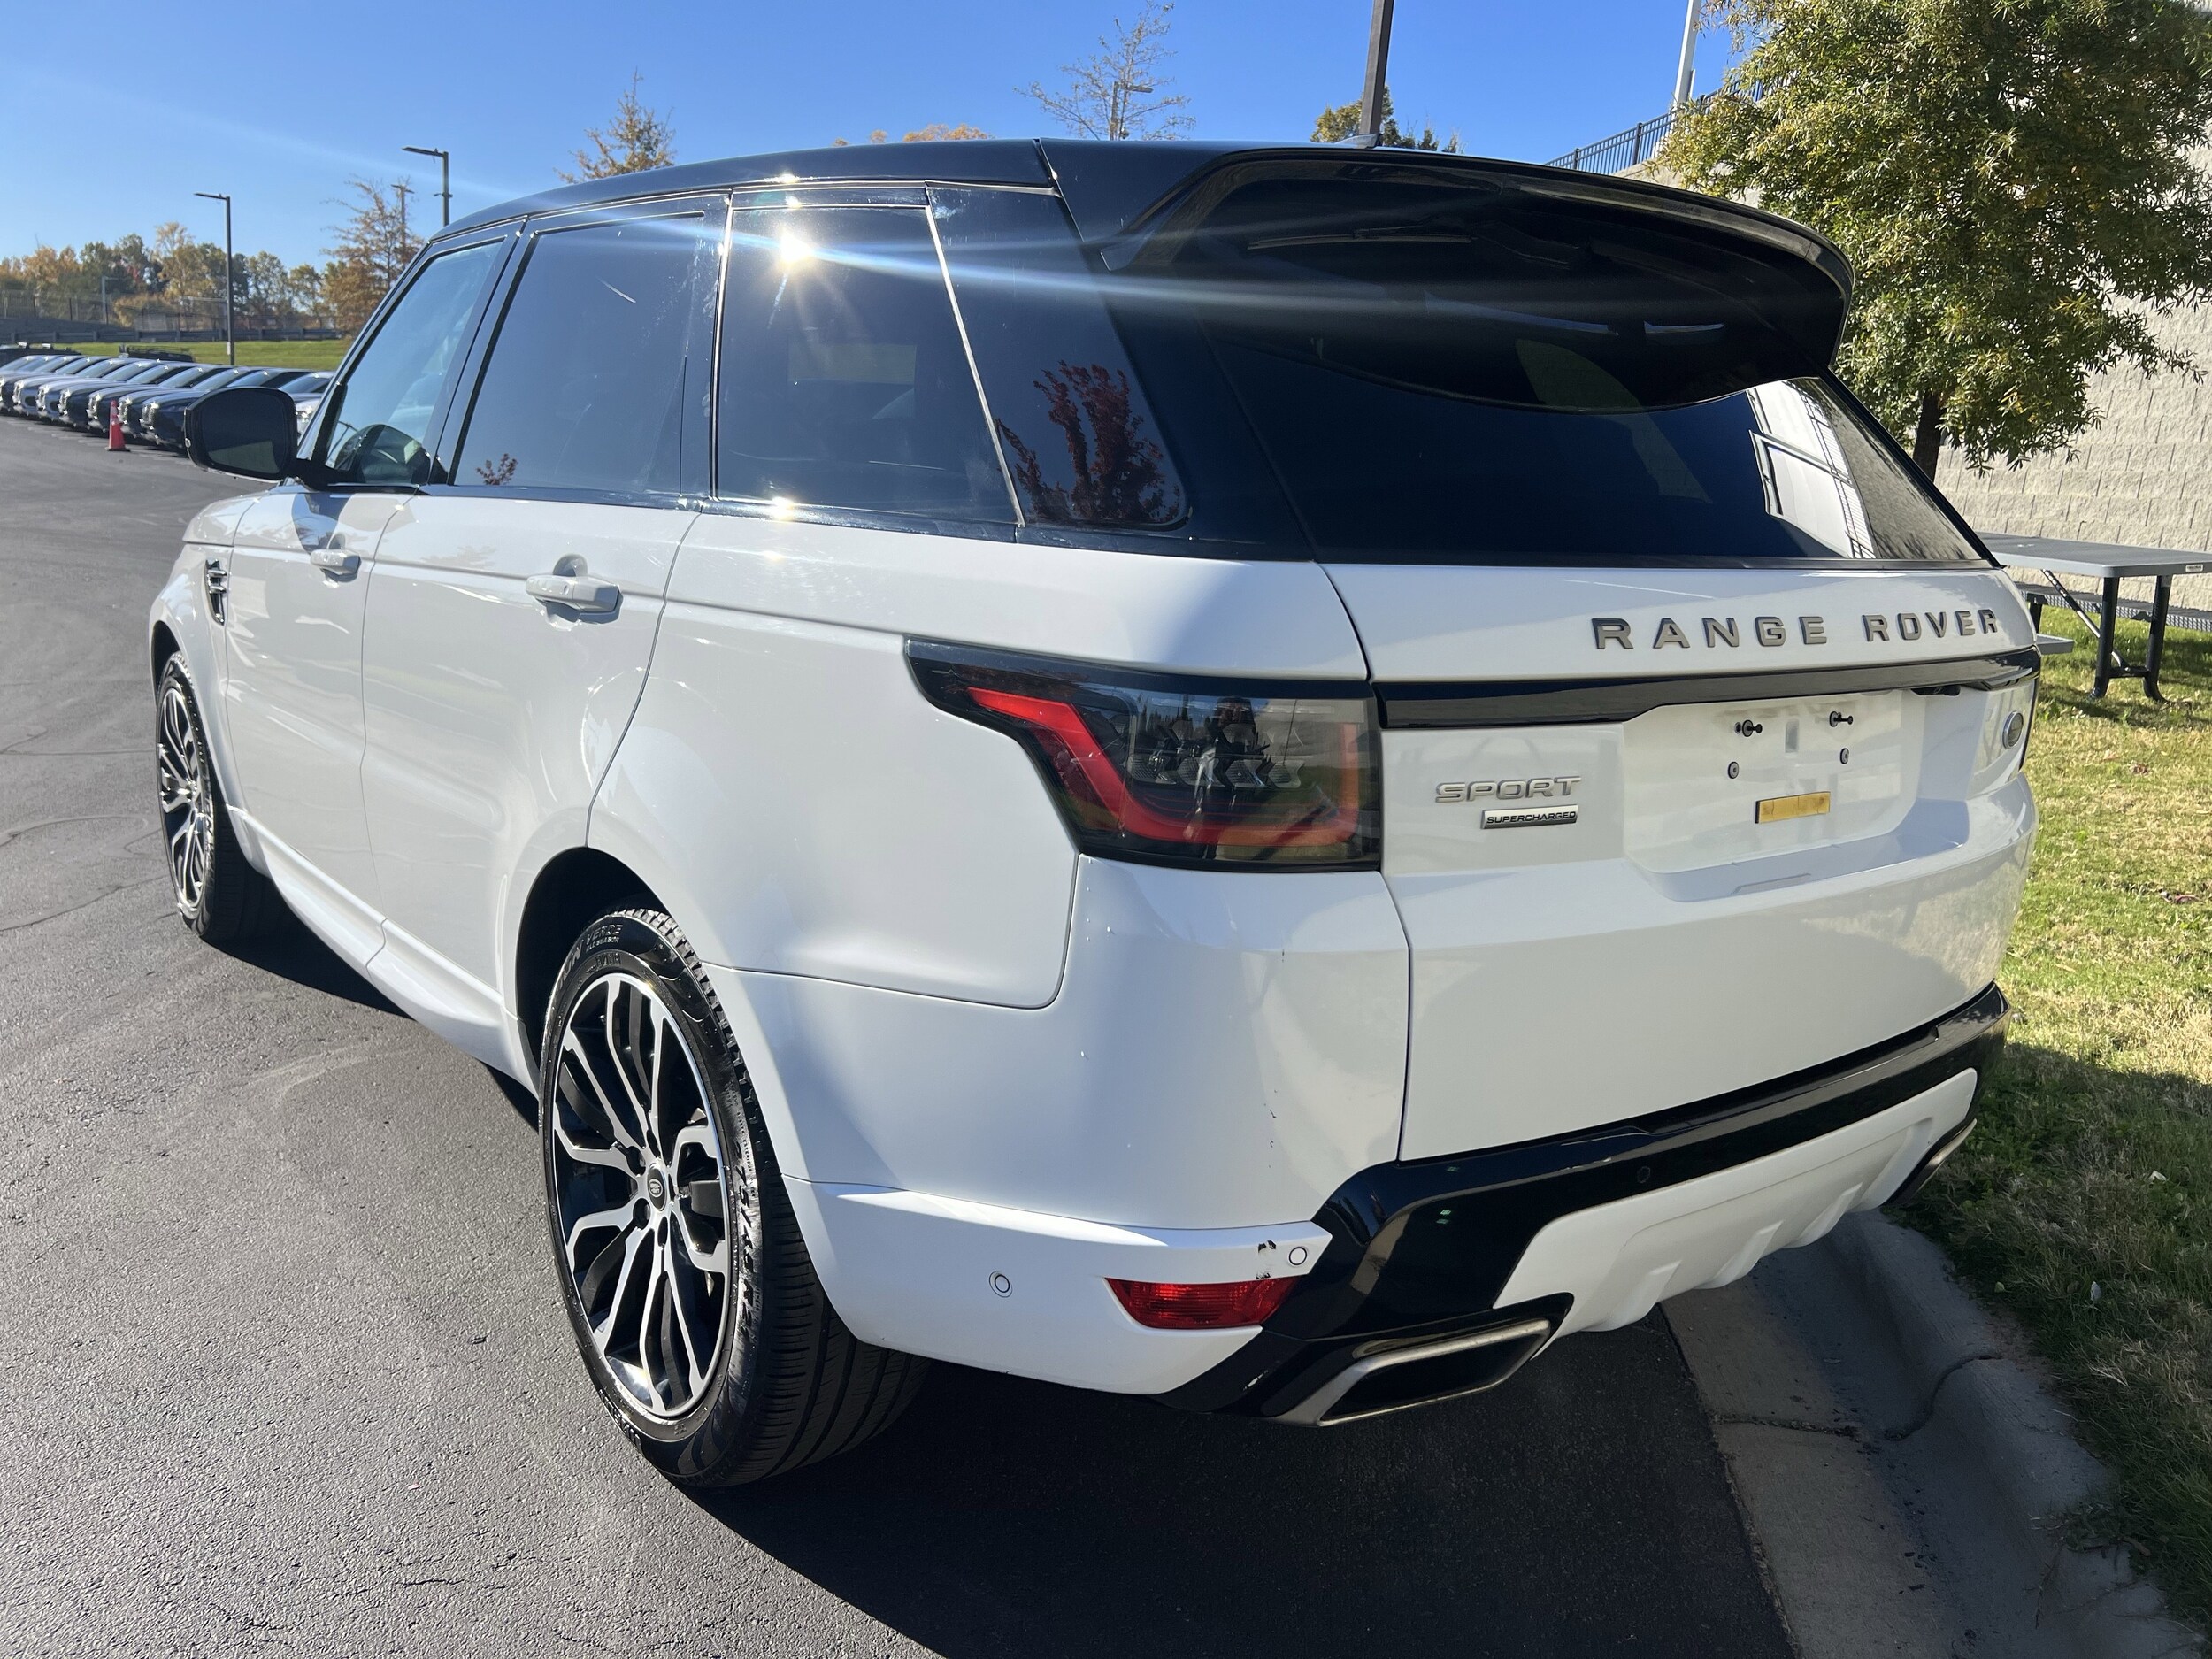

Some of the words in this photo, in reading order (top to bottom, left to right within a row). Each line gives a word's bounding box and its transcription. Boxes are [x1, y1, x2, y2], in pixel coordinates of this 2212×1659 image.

[1591, 616, 1828, 649] RANGE
[1862, 609, 1998, 641] ROVER
[1435, 776, 1582, 803] SPORT
[1486, 810, 1577, 824] SUPERCHARGED
